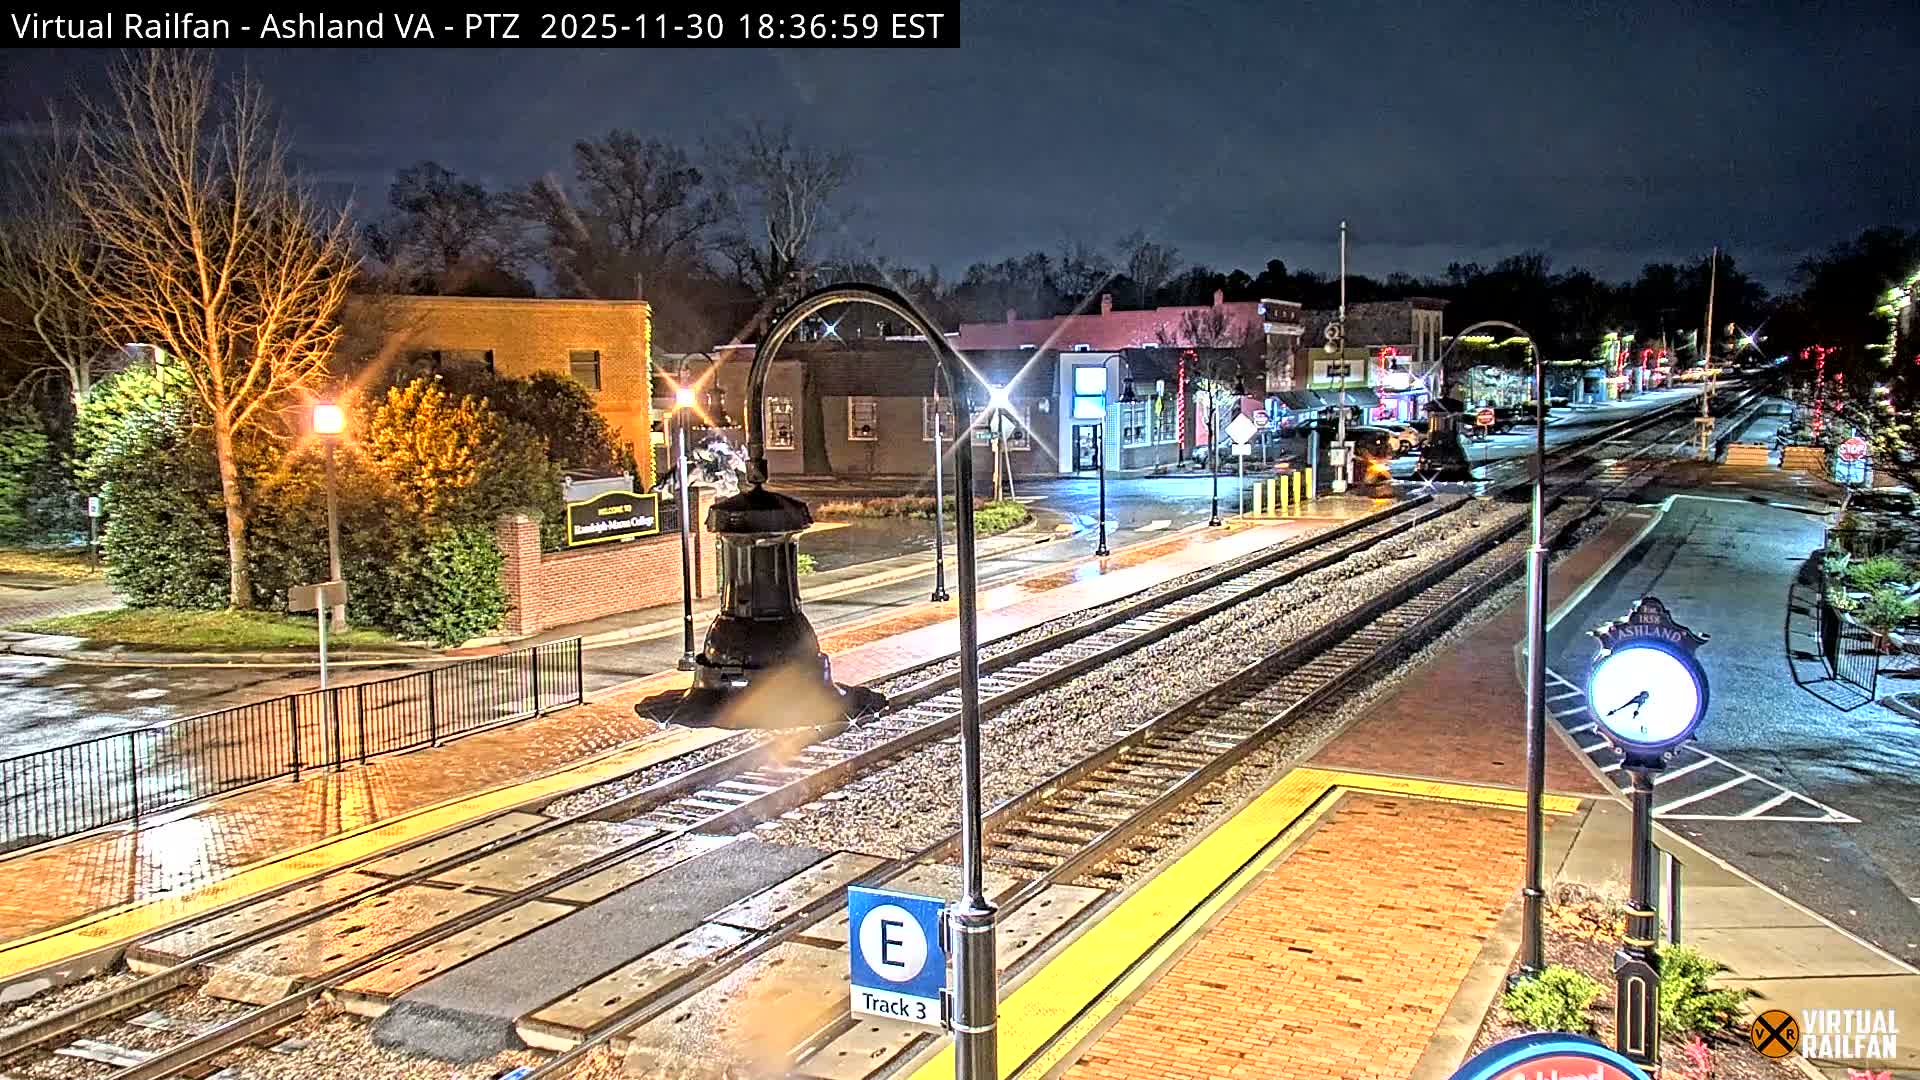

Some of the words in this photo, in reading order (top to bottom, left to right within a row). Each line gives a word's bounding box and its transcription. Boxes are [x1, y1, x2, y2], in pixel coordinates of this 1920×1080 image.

[1840, 443, 1864, 454] STOP
[1618, 624, 1682, 641] ASHLAND
[880, 919, 905, 968] E
[862, 992, 910, 1016] Track
[915, 1001, 927, 1020] 3
